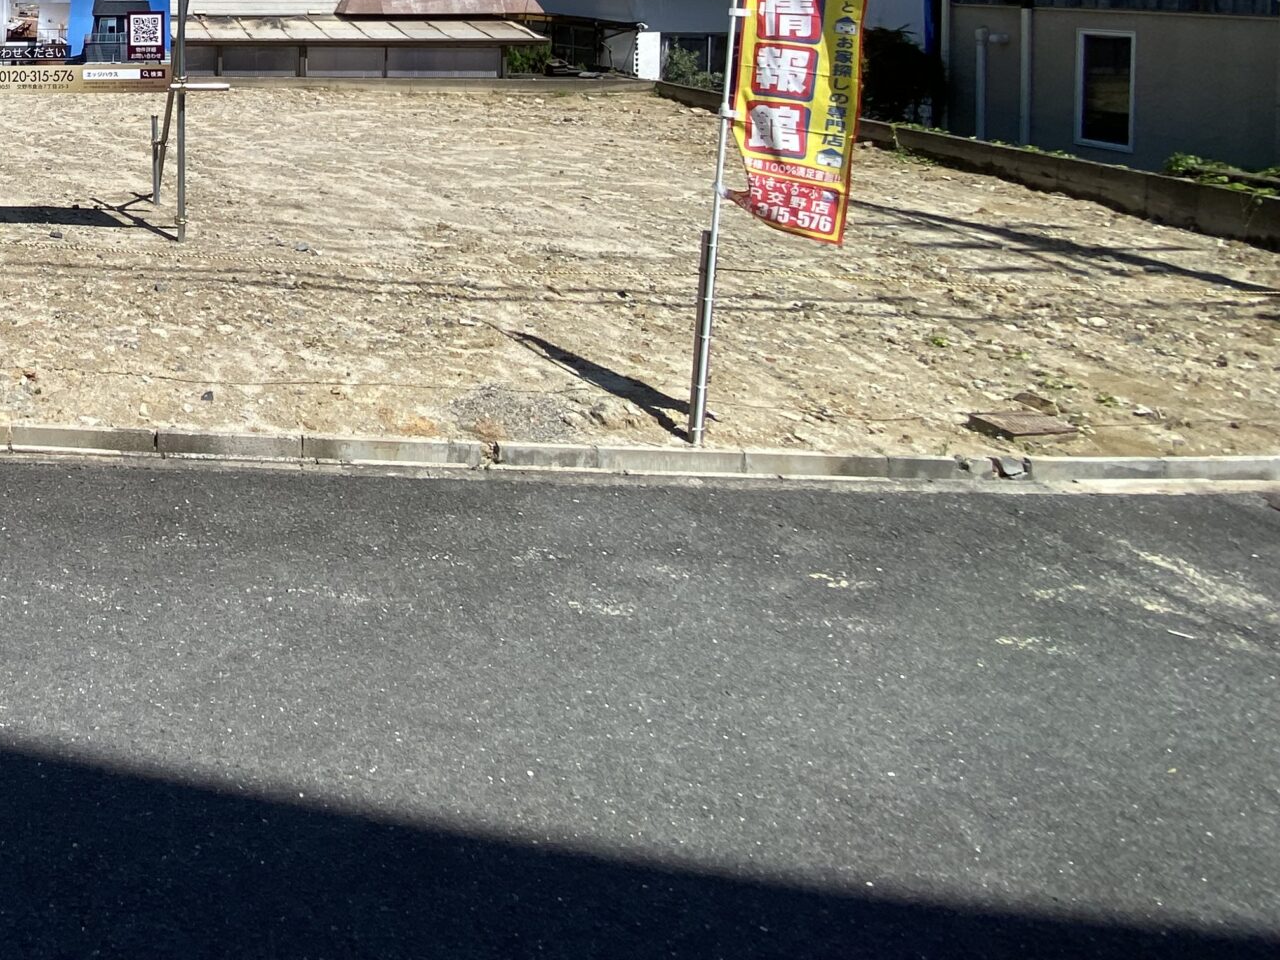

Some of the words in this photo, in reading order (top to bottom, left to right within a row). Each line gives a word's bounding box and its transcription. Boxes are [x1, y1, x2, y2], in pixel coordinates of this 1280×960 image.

[0, 70, 74, 82] 0120-315-576
[822, 38, 853, 147] お家探しの専門店
